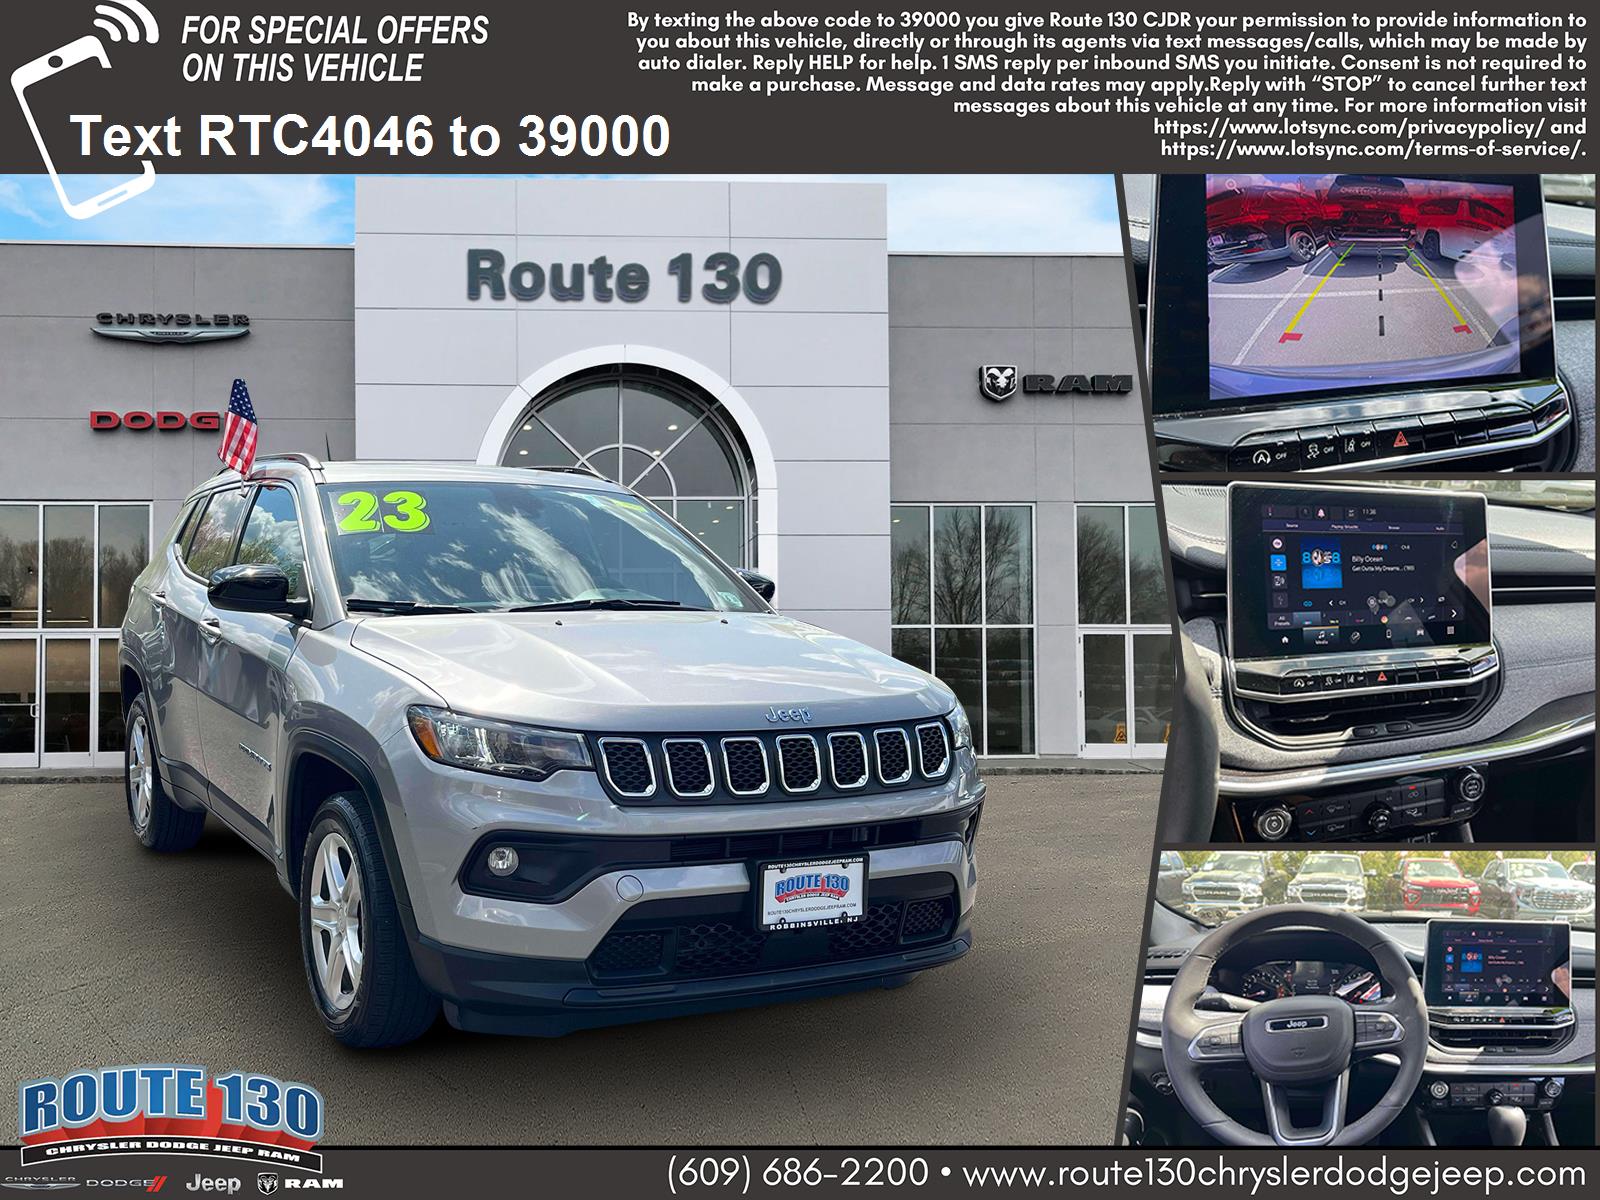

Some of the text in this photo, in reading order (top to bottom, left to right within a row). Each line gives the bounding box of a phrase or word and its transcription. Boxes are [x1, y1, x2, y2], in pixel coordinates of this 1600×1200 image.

[467, 248, 783, 305] Route 130
[96, 312, 250, 326] CHRYSLER
[1023, 374, 1133, 394] RAM
[90, 411, 229, 431] DODG
[1275, 452, 1288, 460] OFF
[1323, 446, 1335, 454] OFF
[337, 491, 431, 532] 23
[765, 706, 812, 725] Jeep
[775, 873, 850, 897] ROUTE 130
[1286, 1020, 1307, 1028] Jeep
